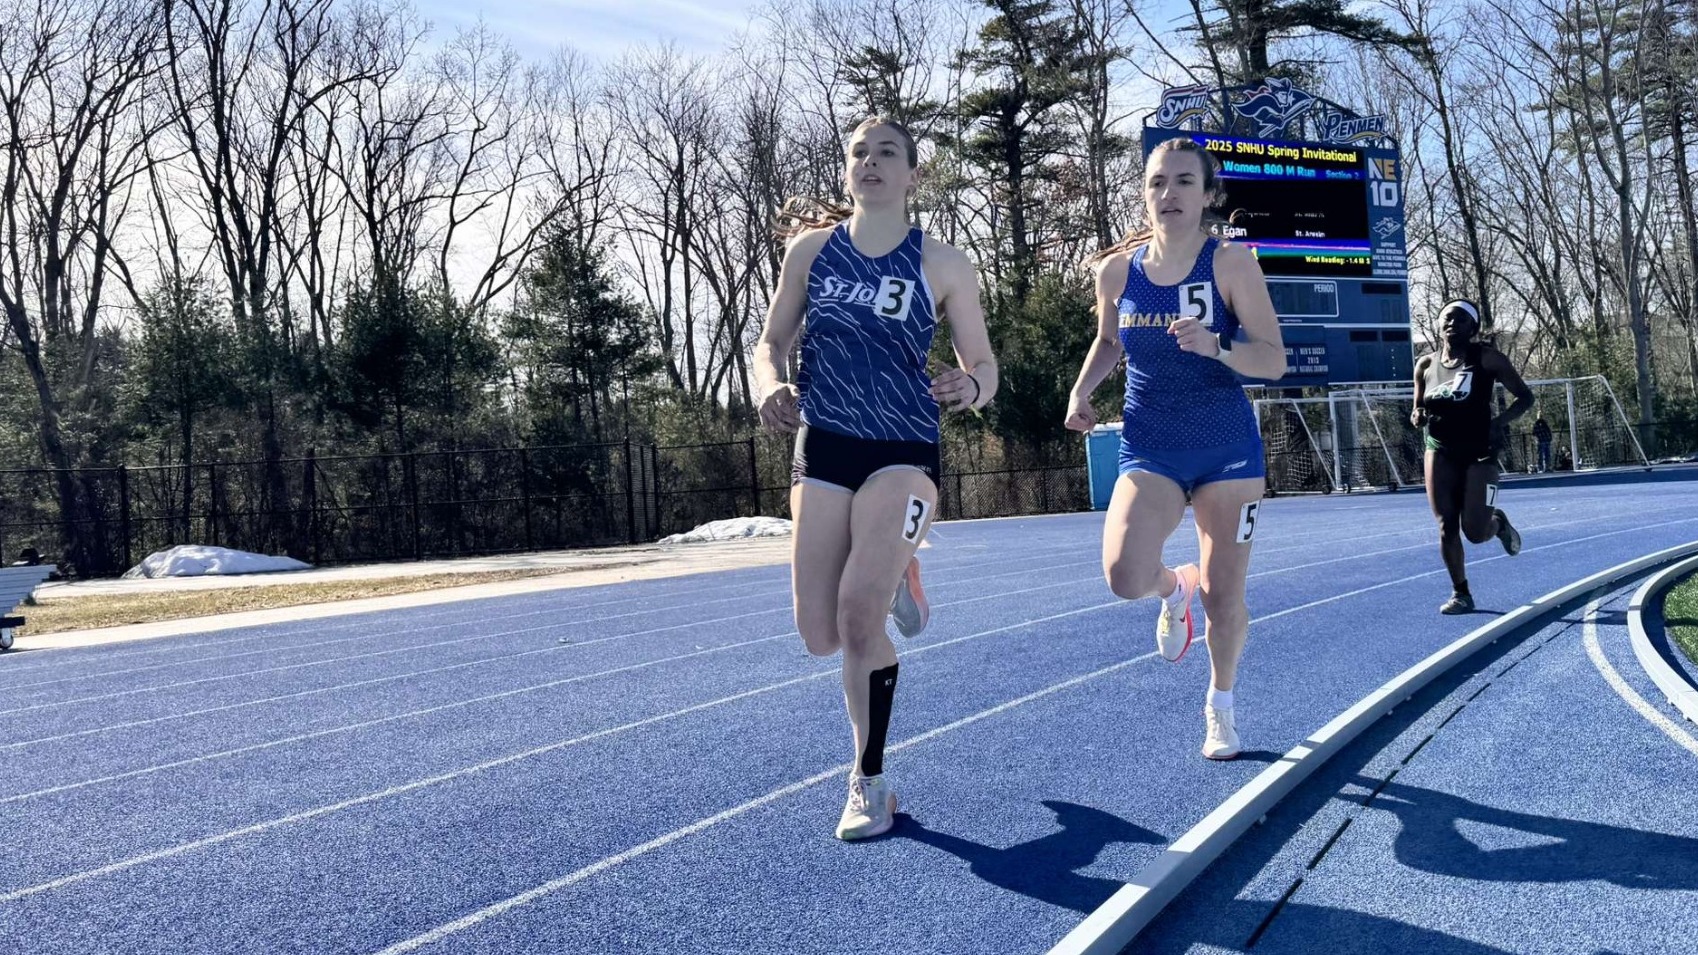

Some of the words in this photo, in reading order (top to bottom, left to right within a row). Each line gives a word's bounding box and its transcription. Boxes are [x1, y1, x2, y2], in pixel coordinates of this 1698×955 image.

[1159, 94, 1206, 123] SNHU
[1323, 113, 1385, 141] PENMEN
[1205, 139, 1233, 152] 2025
[1236, 141, 1264, 155] SNHU
[1267, 145, 1300, 160] Spring
[1302, 147, 1357, 162] Invitational
[1223, 160, 1261, 174] Women
[1264, 164, 1284, 175] 800
[1286, 165, 1295, 176] M
[1297, 166, 1316, 177] Run
[1367, 157, 1397, 181] NE
[1370, 180, 1399, 207] 10
[1211, 224, 1218, 235] 6
[1222, 225, 1247, 238] Egan
[1305, 255, 1320, 263] Wind
[881, 279, 906, 316] 3
[1313, 284, 1335, 293] PERIOD
[1187, 284, 1207, 322] 5
[1118, 312, 1180, 328] EMMAN
[1457, 373, 1468, 391] 7
[1489, 486, 1496, 506] 7
[905, 499, 924, 540] 3
[1243, 503, 1257, 541] 5
[884, 678, 893, 686] KT
